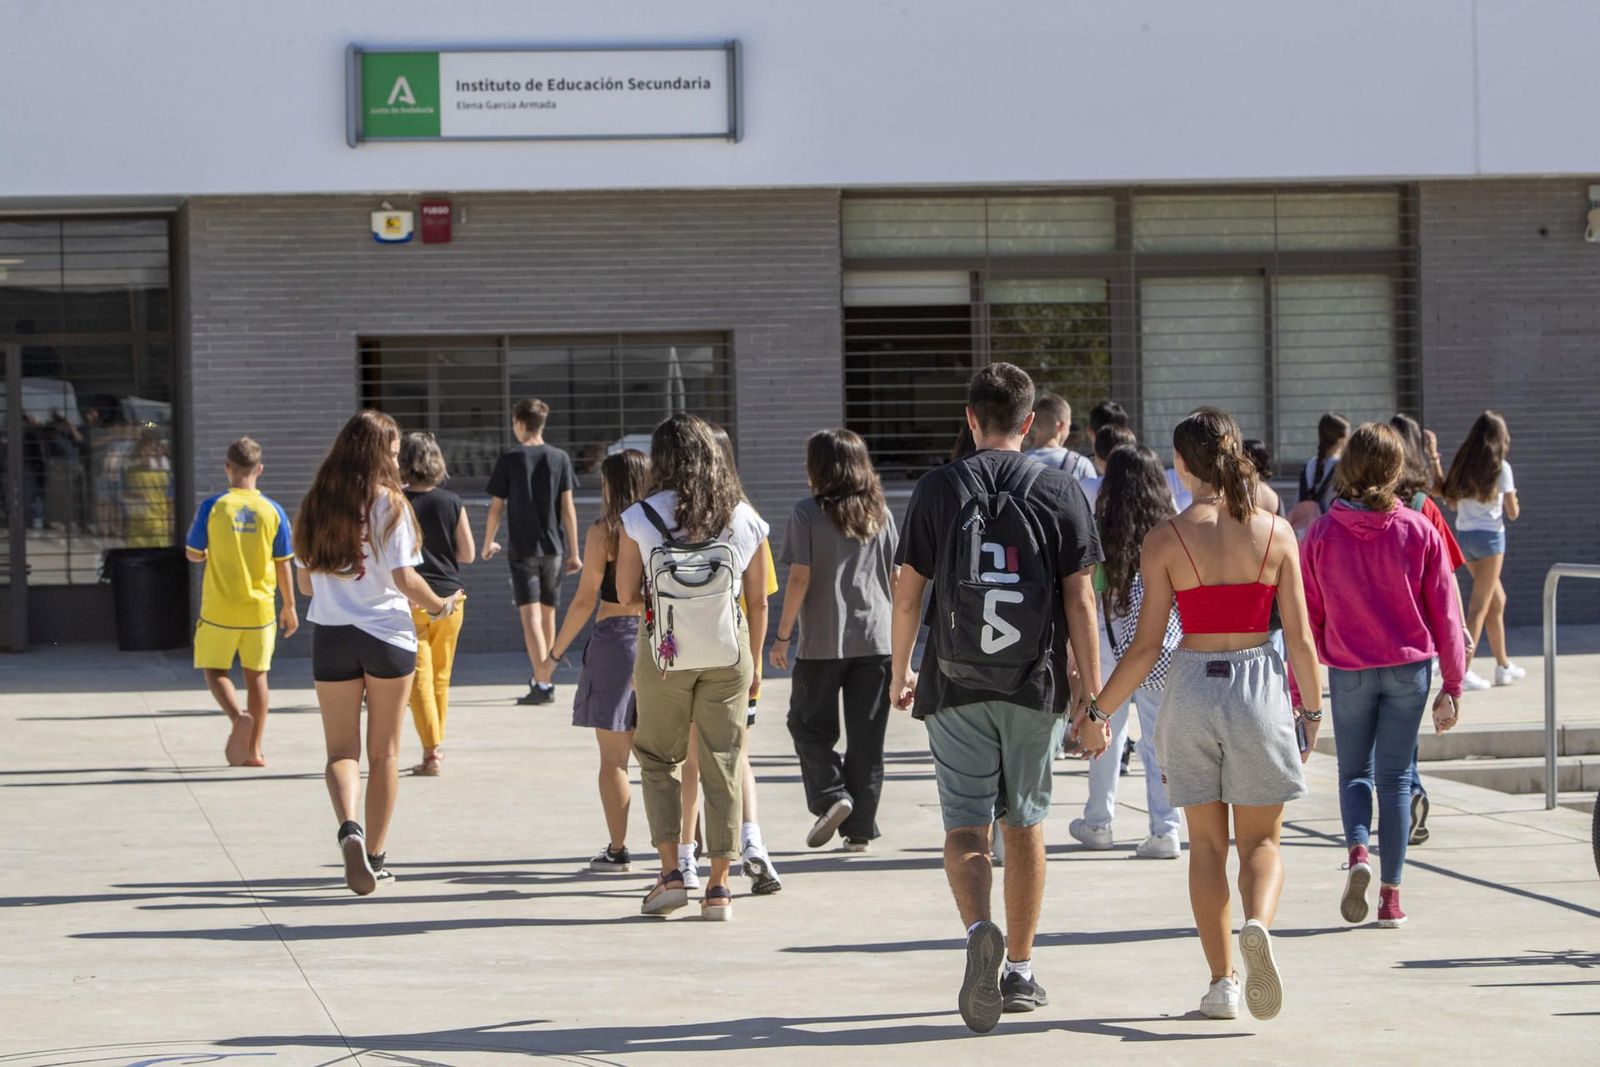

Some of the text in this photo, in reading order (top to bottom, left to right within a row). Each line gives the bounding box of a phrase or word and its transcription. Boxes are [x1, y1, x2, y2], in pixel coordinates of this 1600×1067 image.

[456, 76, 711, 92] Instituto de Educación Secundaria
[456, 101, 483, 110] Elena
[519, 100, 557, 109] Armada
[980, 542, 1024, 655] FILA
